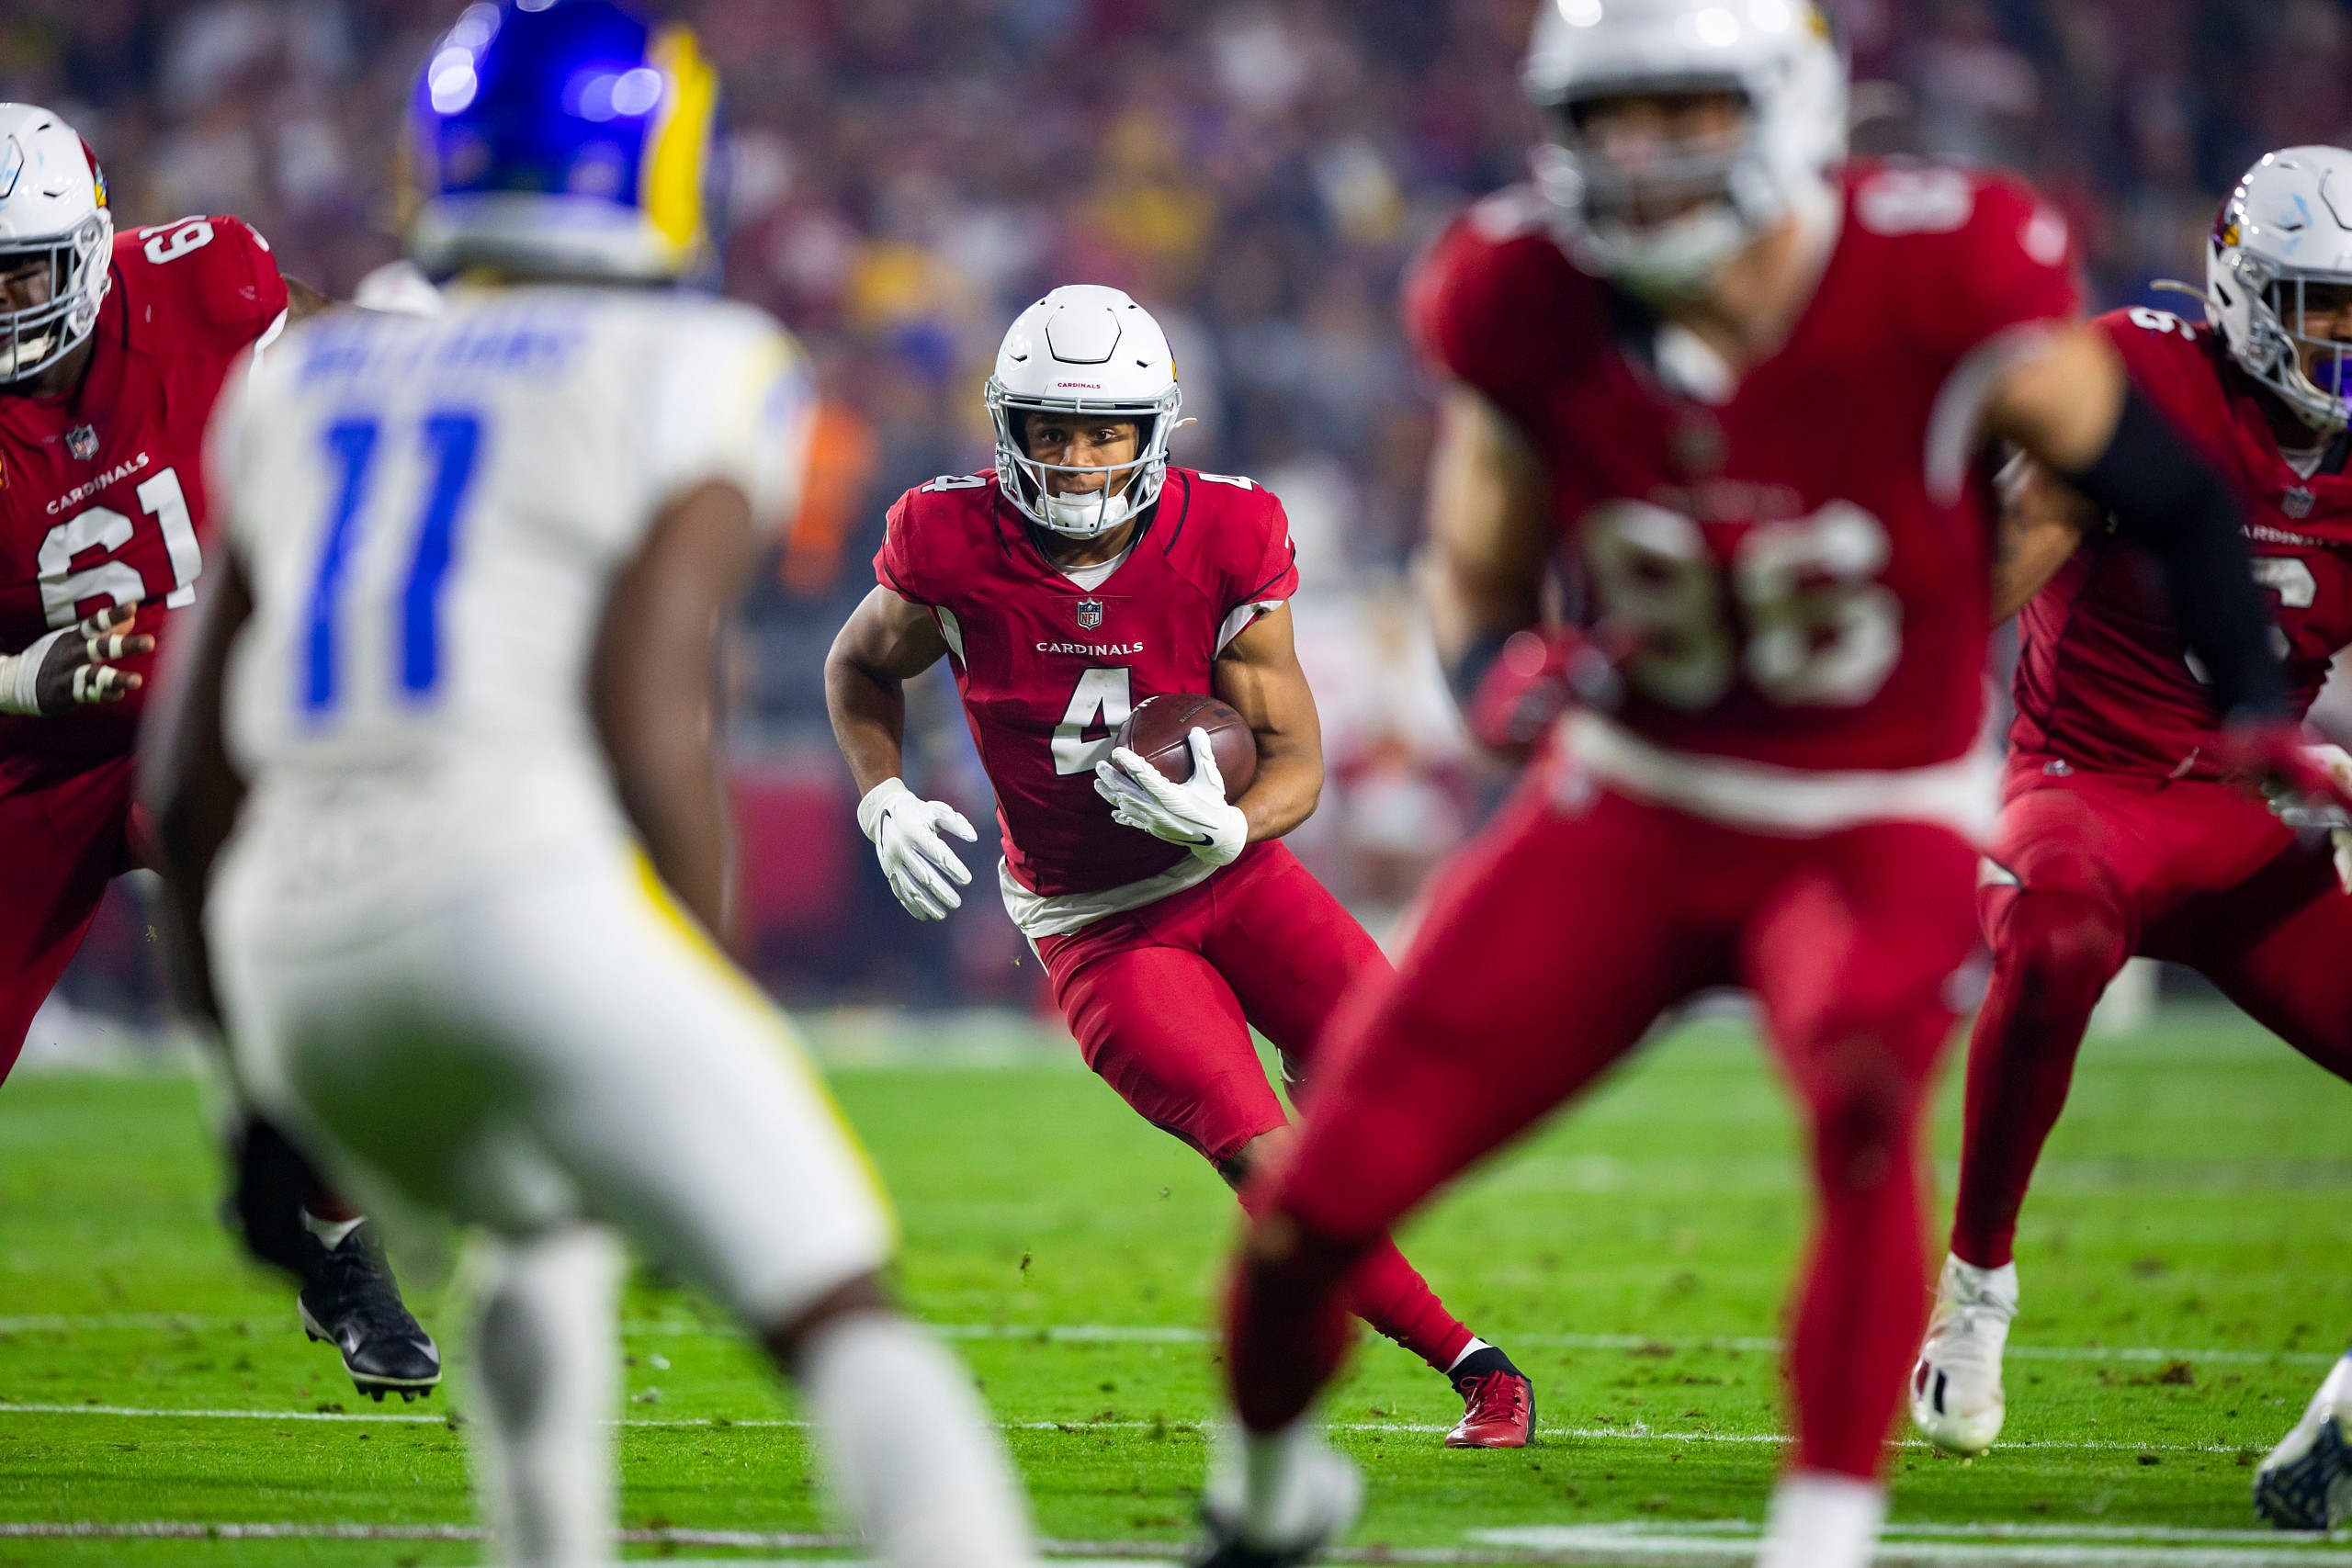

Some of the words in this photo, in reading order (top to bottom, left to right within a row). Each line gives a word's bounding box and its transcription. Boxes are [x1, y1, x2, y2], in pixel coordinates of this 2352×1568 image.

[46, 452, 149, 515] CARDINALS
[38, 466, 203, 629] 61
[299, 409, 482, 712] 11
[1035, 642, 1144, 656] CARDINALS
[1050, 667, 1134, 776] 4
